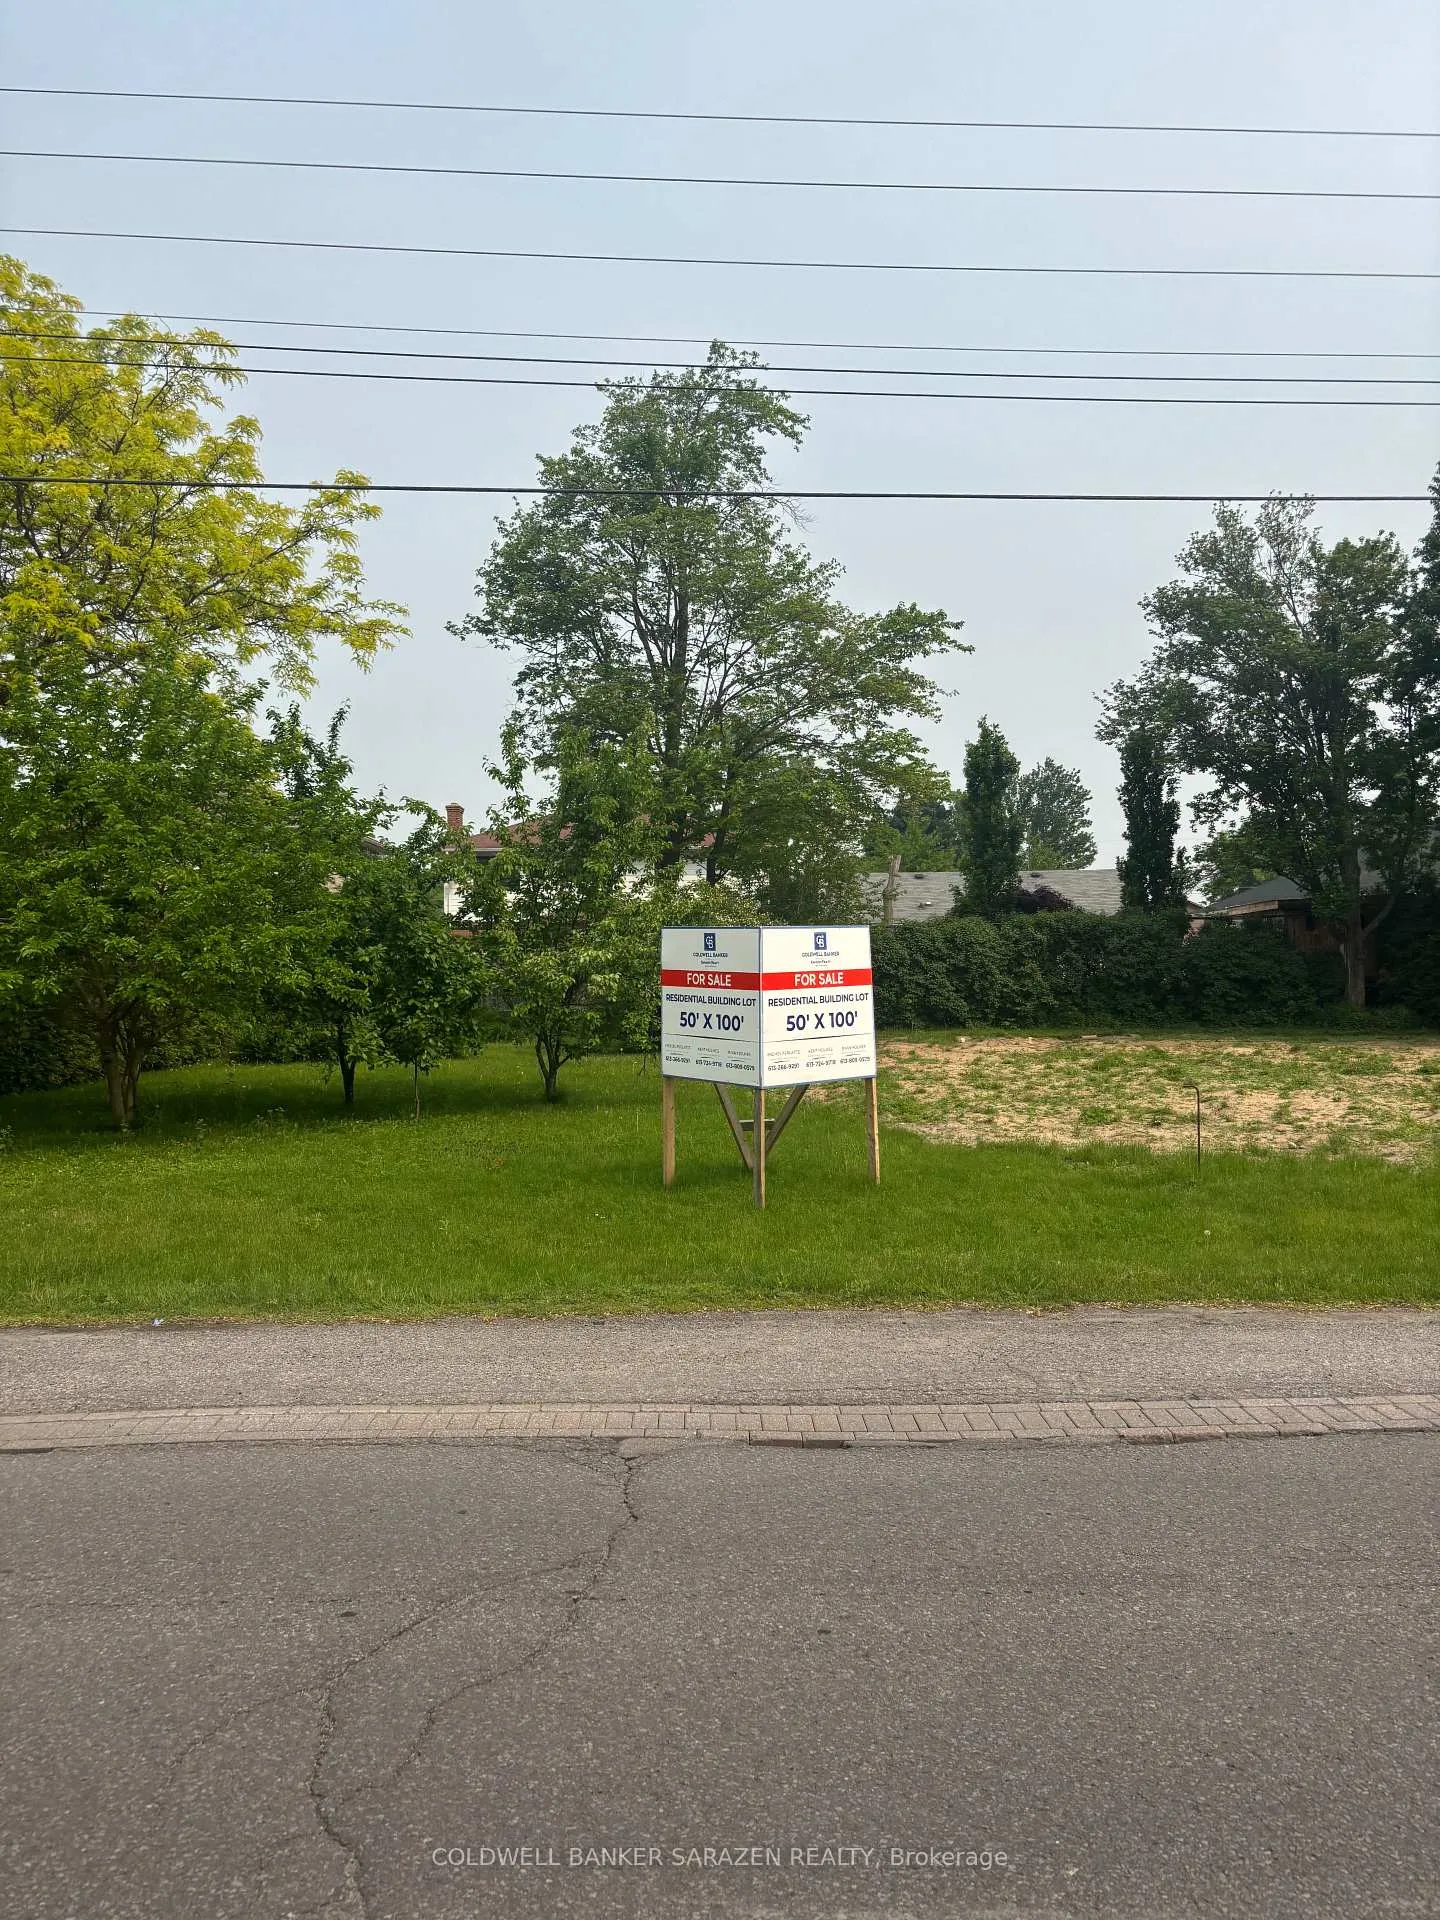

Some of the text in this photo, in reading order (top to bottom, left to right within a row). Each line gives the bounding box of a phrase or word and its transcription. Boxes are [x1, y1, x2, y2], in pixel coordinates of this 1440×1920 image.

[687, 973, 732, 986] FOR SALE
[794, 972, 844, 987] FOR SALE
[666, 994, 756, 1007] RESIDENTIAL BUILDING LOT
[768, 993, 869, 1007] RESIDENTIAL BUILDING LOT
[680, 1012, 744, 1031] 50' X 100'
[786, 1011, 858, 1031] 50' X 100'
